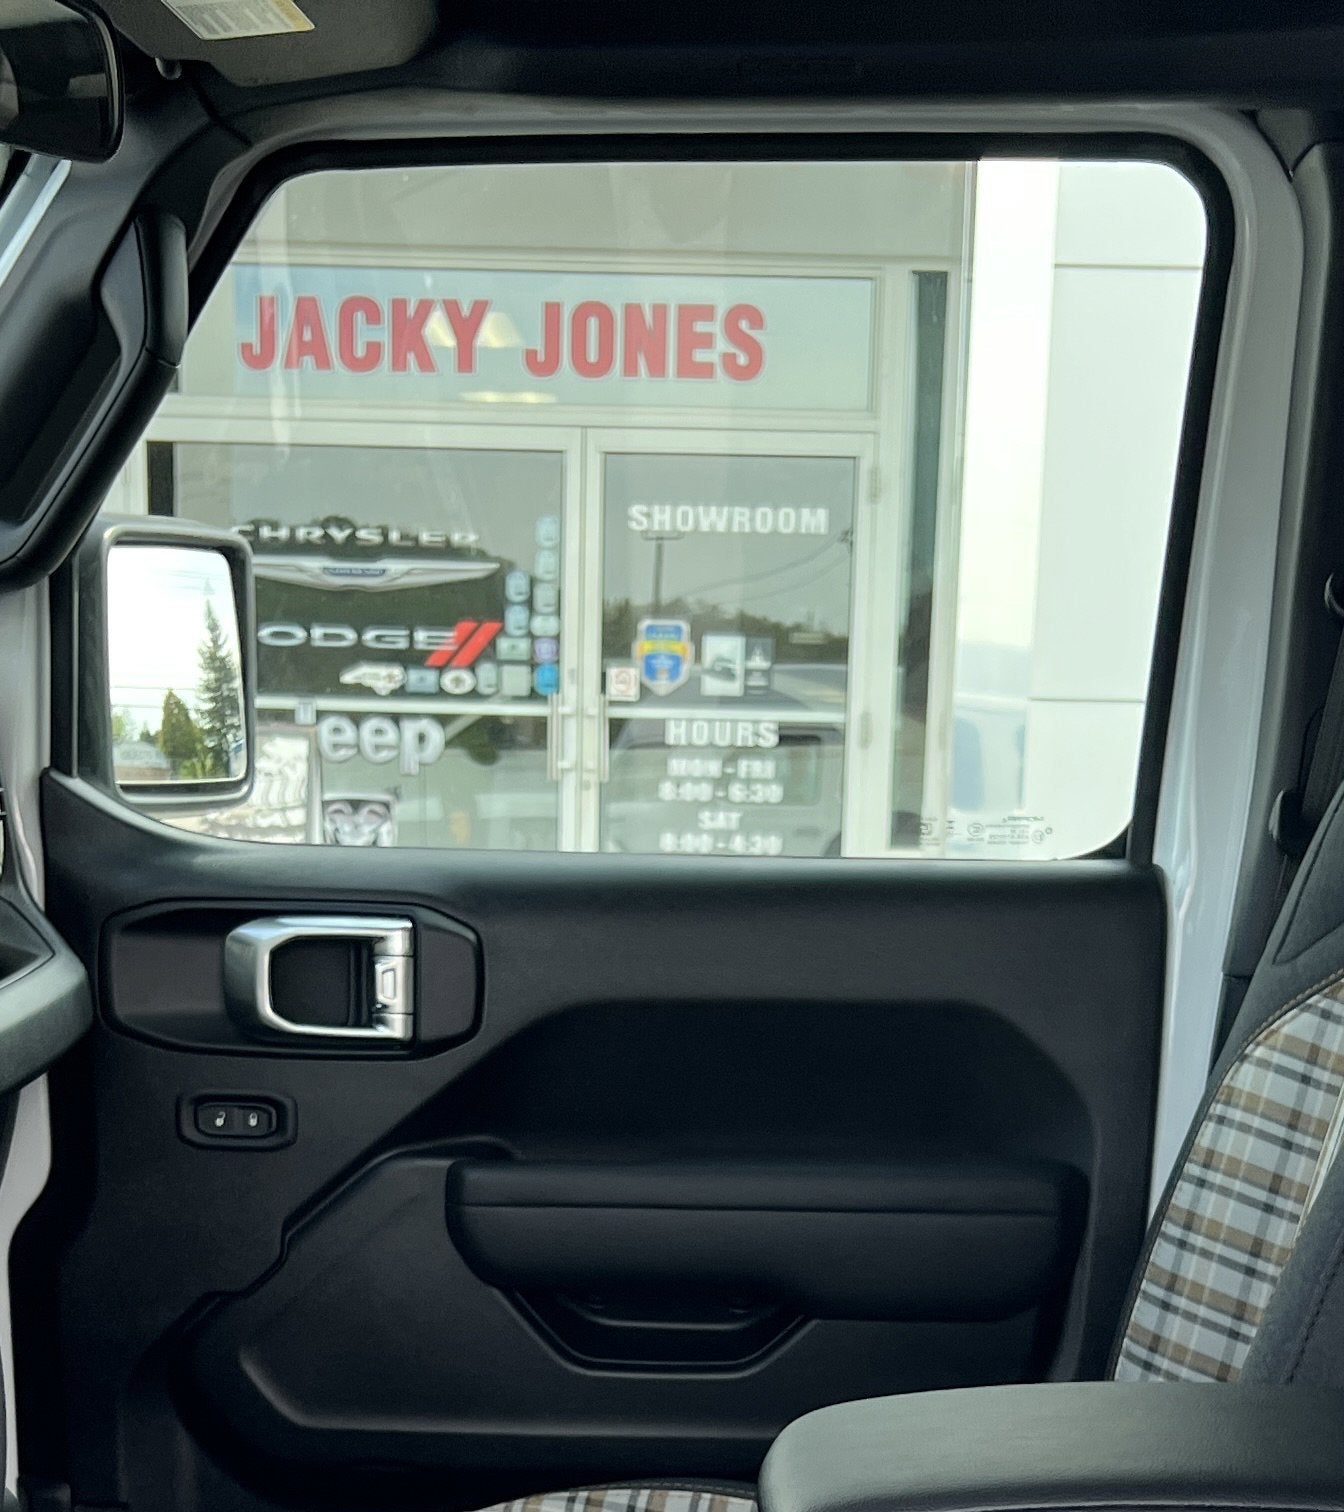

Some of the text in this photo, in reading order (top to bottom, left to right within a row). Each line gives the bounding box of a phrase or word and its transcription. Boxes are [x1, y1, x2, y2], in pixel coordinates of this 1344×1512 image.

[239, 294, 767, 382] JACKY JONES
[627, 504, 830, 535] SHOWROOM
[256, 621, 458, 651] ODGE
[664, 718, 780, 748] HOURS
[697, 810, 743, 831] SAT
